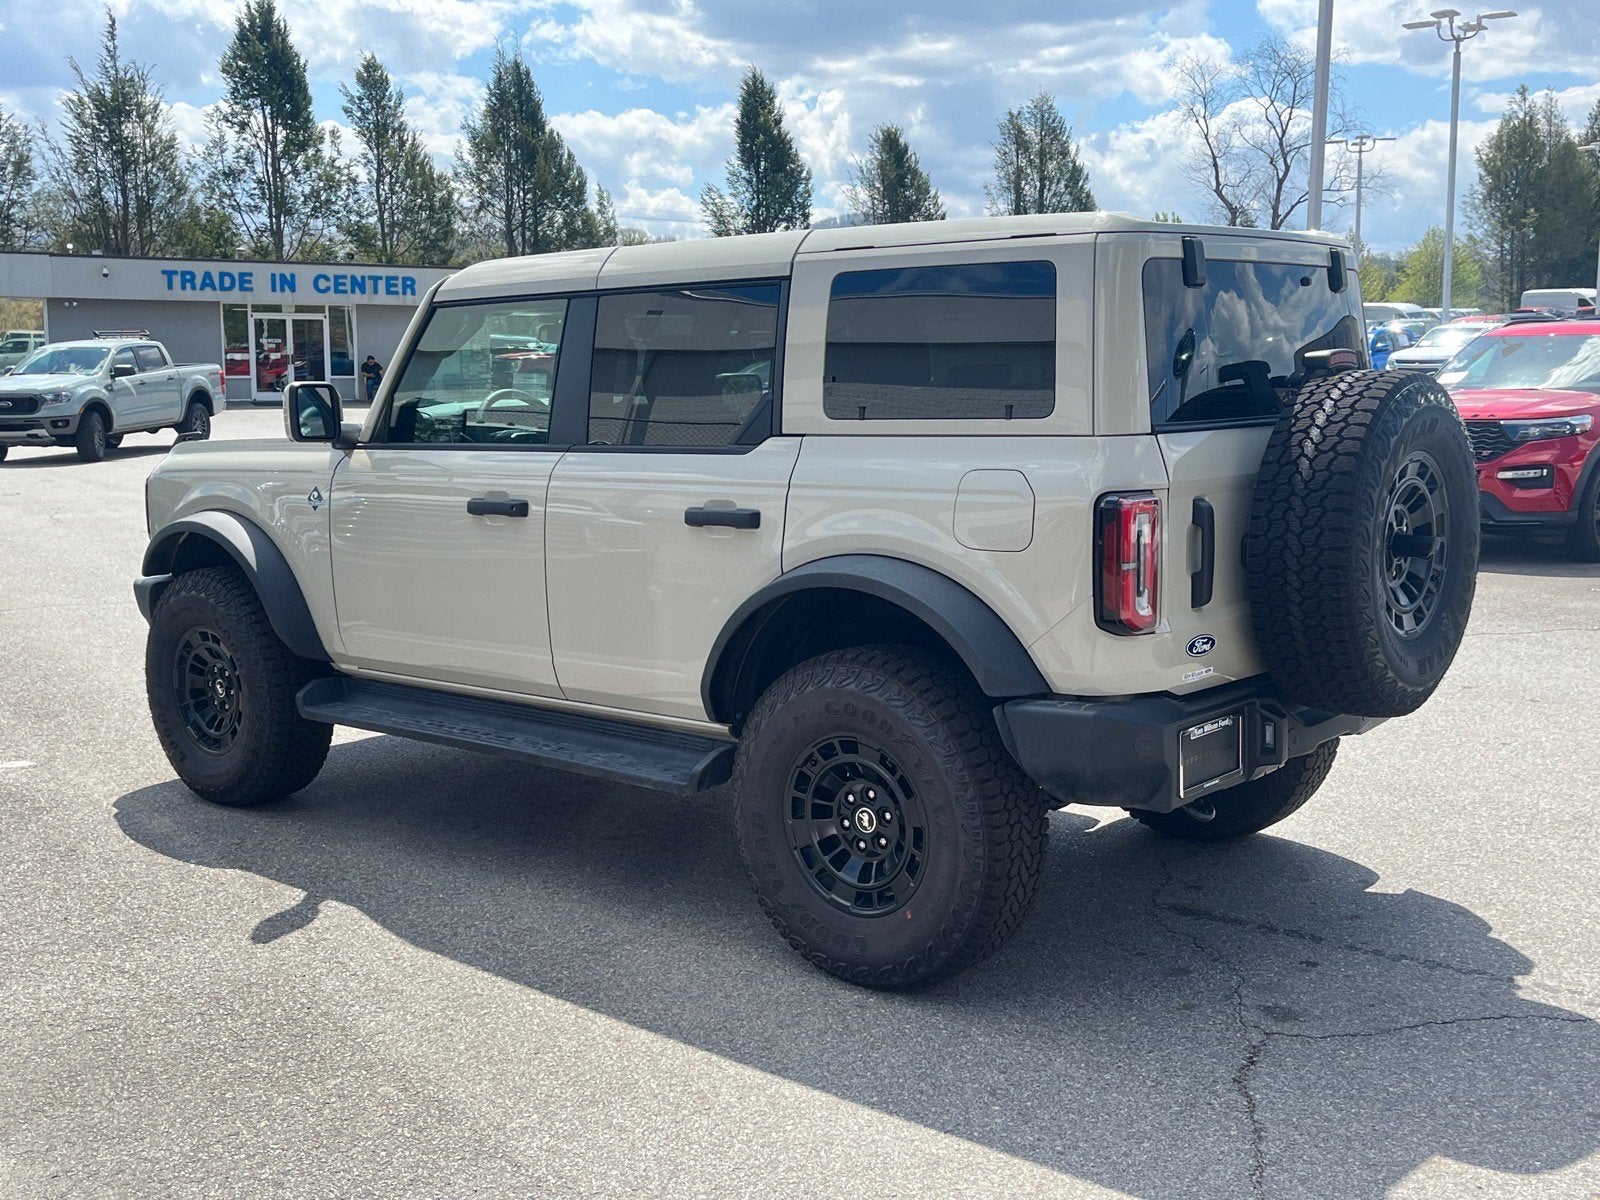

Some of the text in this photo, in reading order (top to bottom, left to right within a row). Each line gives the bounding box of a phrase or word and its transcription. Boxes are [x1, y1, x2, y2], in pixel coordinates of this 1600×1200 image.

[161, 269, 417, 296] TRADE IN CENTER
[1203, 722, 1219, 733] Wilson
[1218, 717, 1229, 729] Ford
